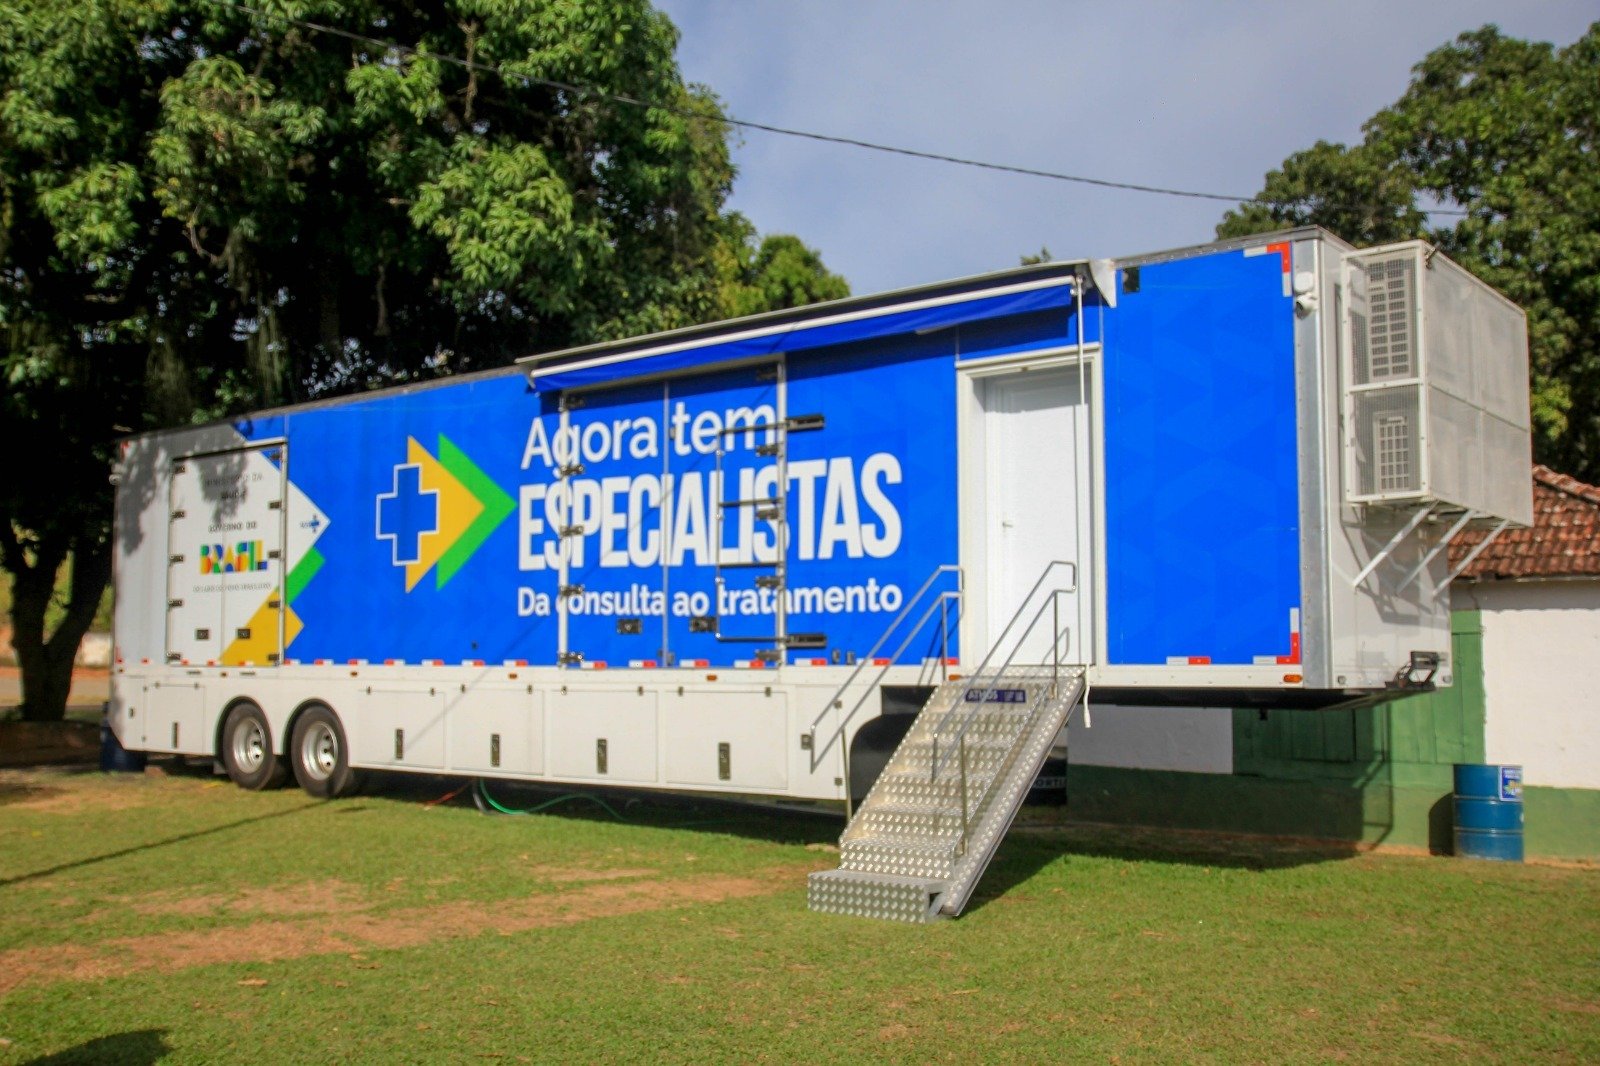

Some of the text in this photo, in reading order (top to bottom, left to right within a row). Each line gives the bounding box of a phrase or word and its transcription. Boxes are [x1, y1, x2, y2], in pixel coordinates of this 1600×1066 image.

[520, 401, 776, 477] Agora tem
[518, 452, 902, 571] ESPECIALISTAS
[200, 540, 267, 574] BRASIL
[518, 587, 549, 616] Da
[673, 591, 710, 616] ao
[718, 578, 903, 616] tratamento
